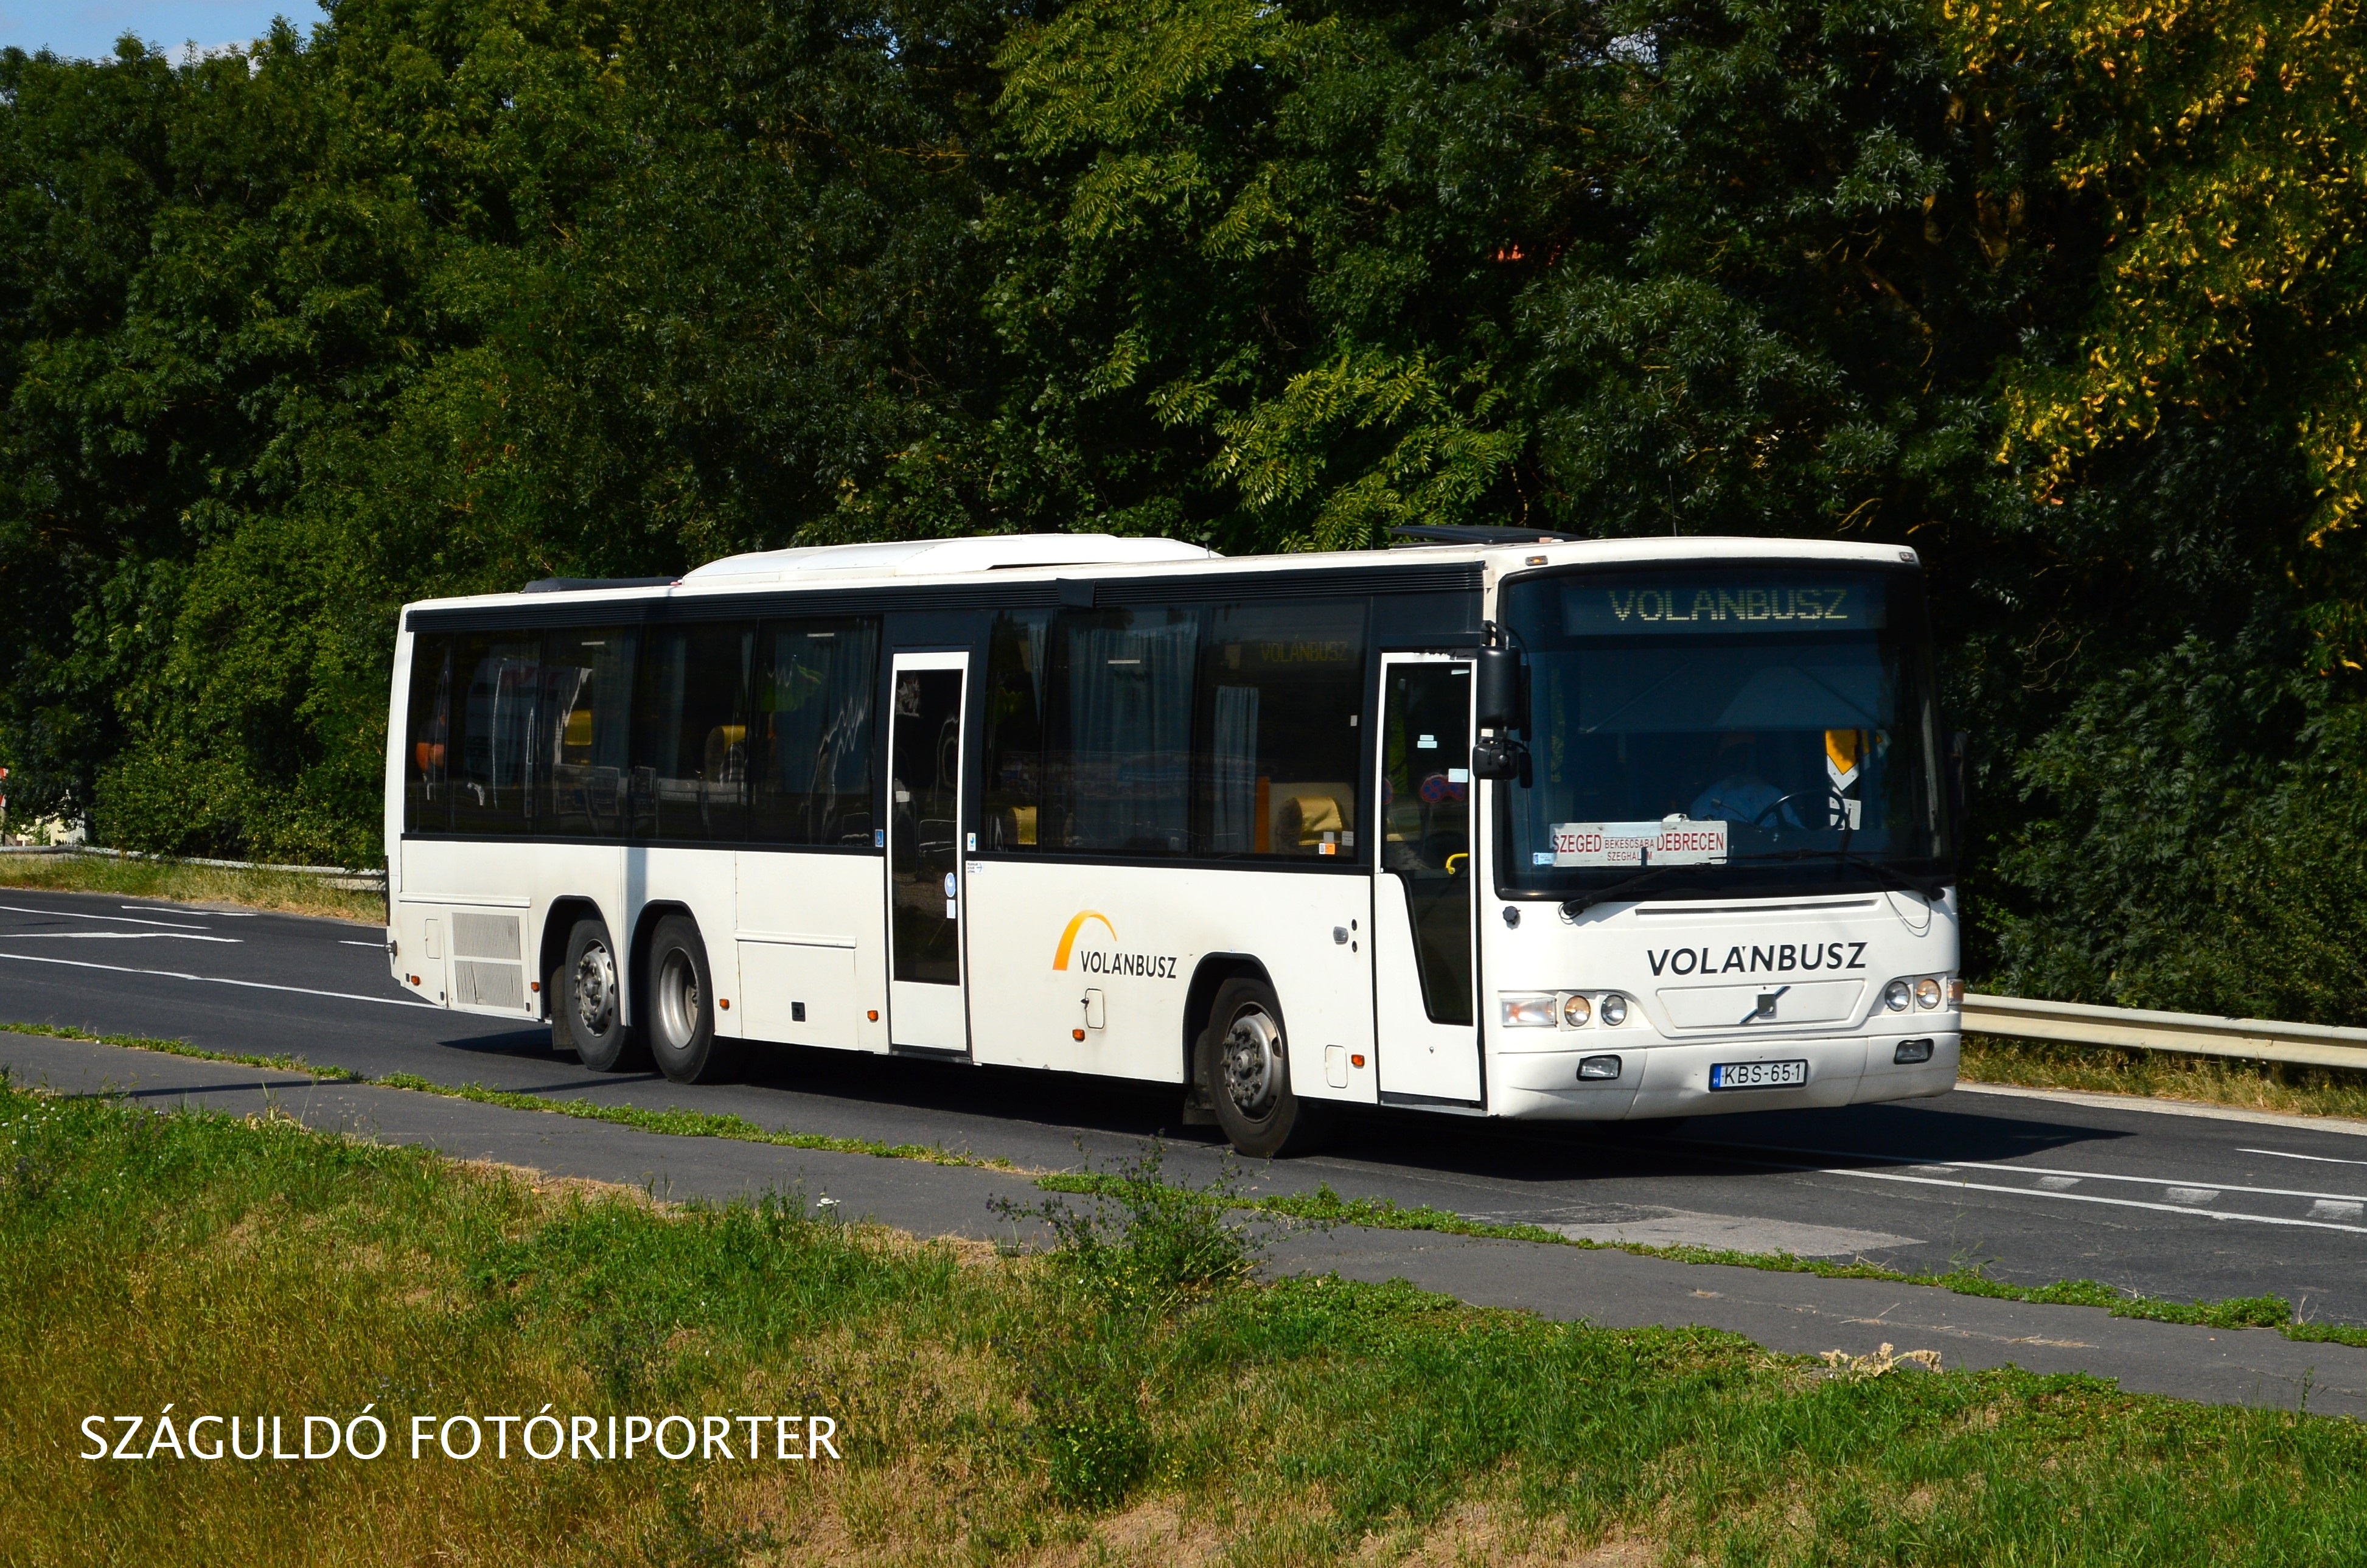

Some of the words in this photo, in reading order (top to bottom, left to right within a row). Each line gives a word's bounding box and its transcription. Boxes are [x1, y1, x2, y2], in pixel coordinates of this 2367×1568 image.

[1553, 834, 1602, 853] SZEGED
[1657, 832, 1724, 851] DEBRECEN
[1607, 851, 1653, 862] SZEGHALM
[1081, 950, 1177, 979] VOLÁNBUSZ
[1647, 942, 1869, 977] VOLÁNBUSZ
[1724, 1063, 1801, 1085] KBS-651
